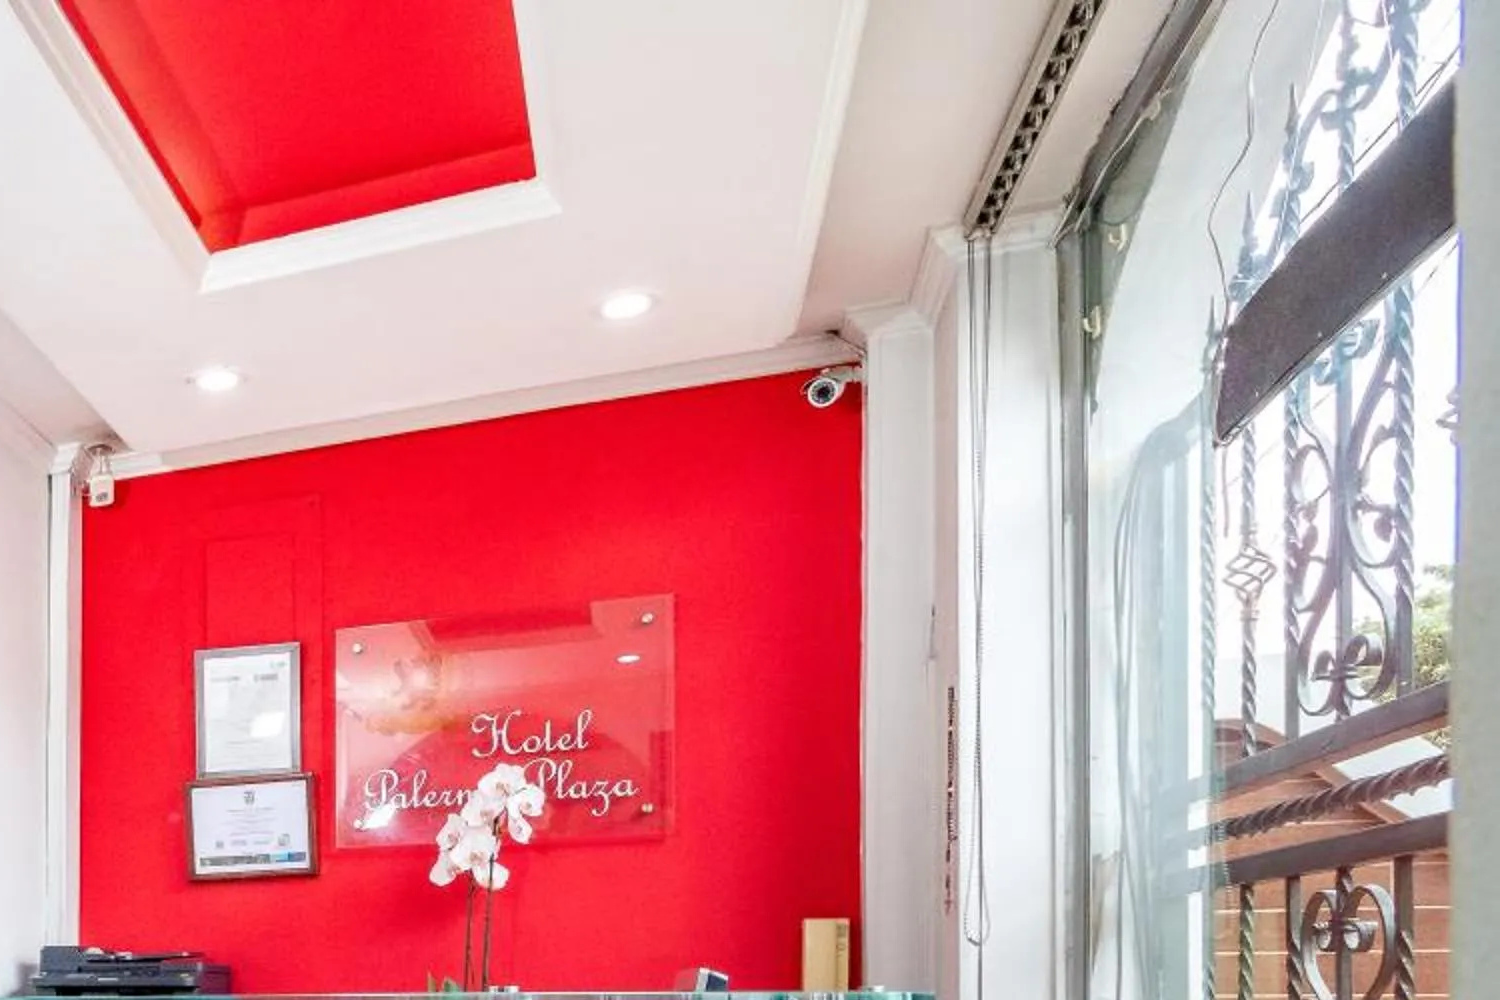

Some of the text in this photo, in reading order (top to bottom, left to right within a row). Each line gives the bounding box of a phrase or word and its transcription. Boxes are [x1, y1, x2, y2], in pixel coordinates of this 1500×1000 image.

[471, 709, 592, 757] Hotel
[365, 757, 640, 817] Paler Plaza
